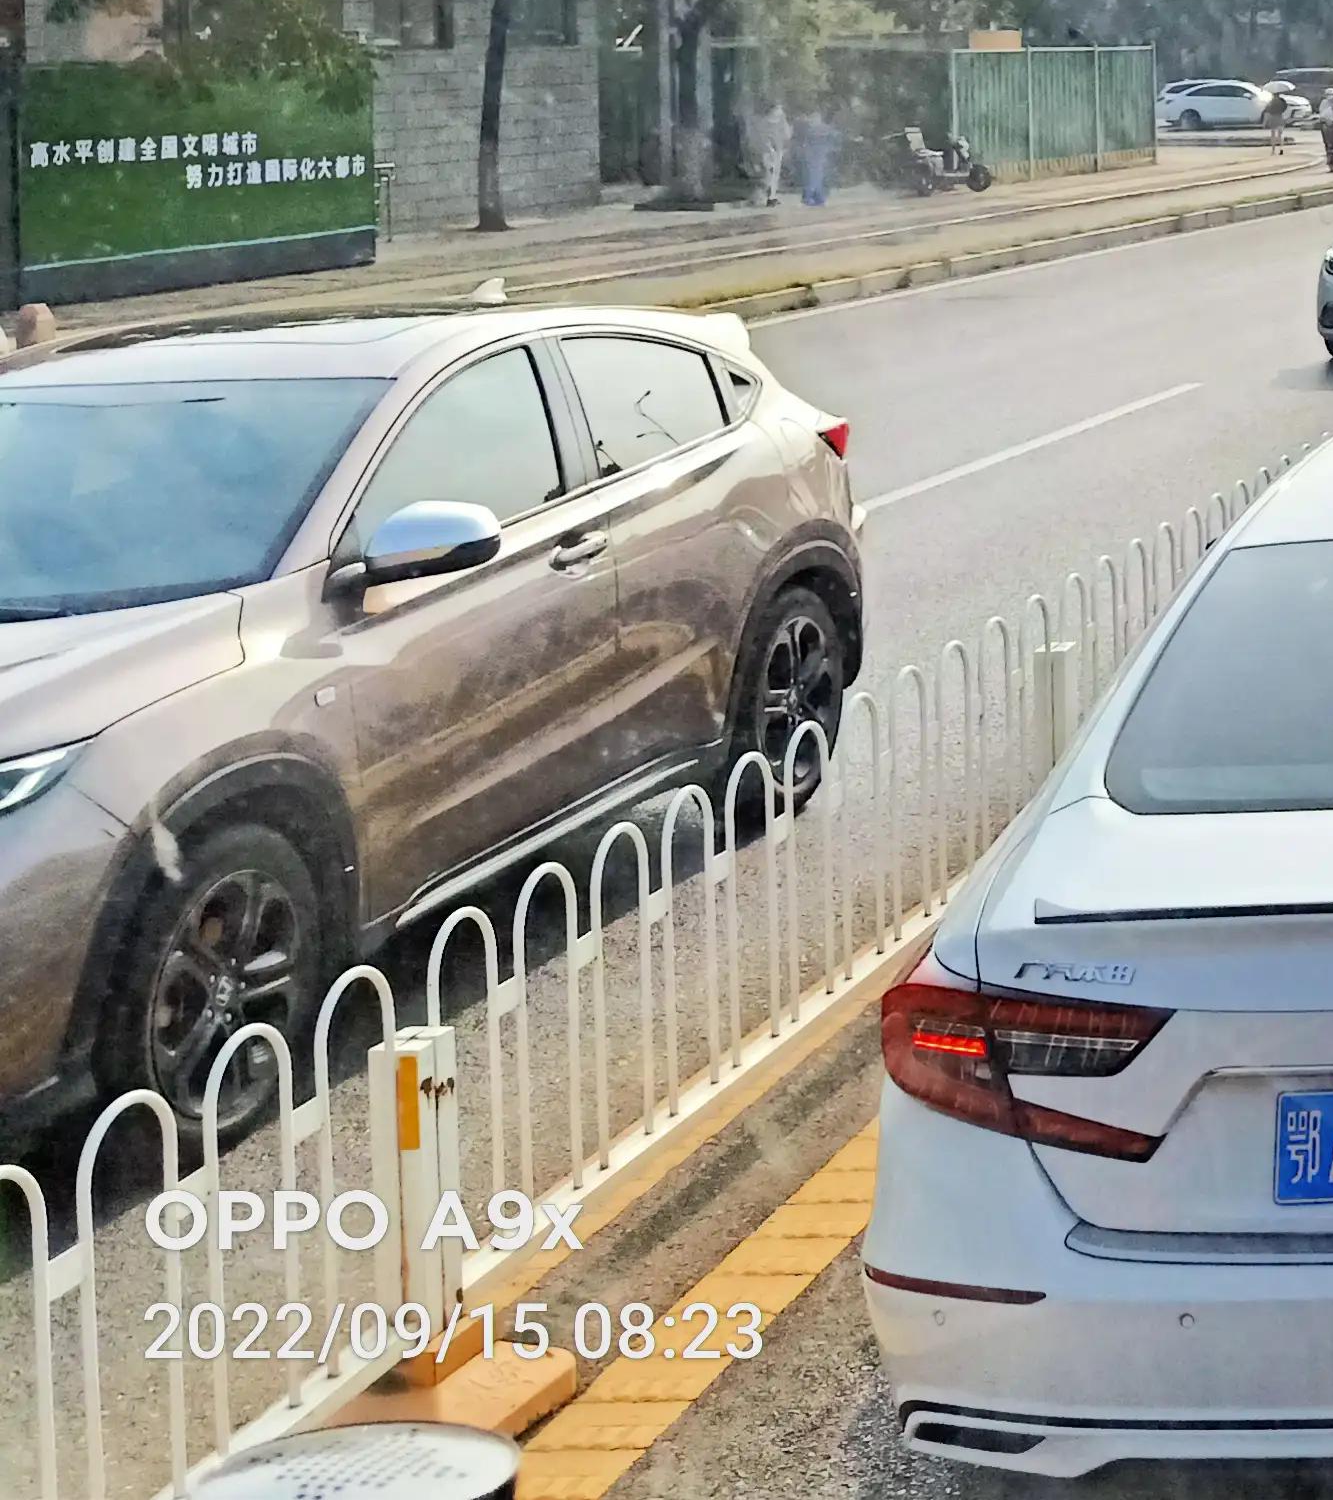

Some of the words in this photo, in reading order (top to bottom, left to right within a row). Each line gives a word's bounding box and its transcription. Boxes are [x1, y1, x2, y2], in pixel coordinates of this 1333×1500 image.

[30, 132, 257, 169] 高水平创建全国文明城市
[186, 154, 366, 189] 努力打造国际化大都市
